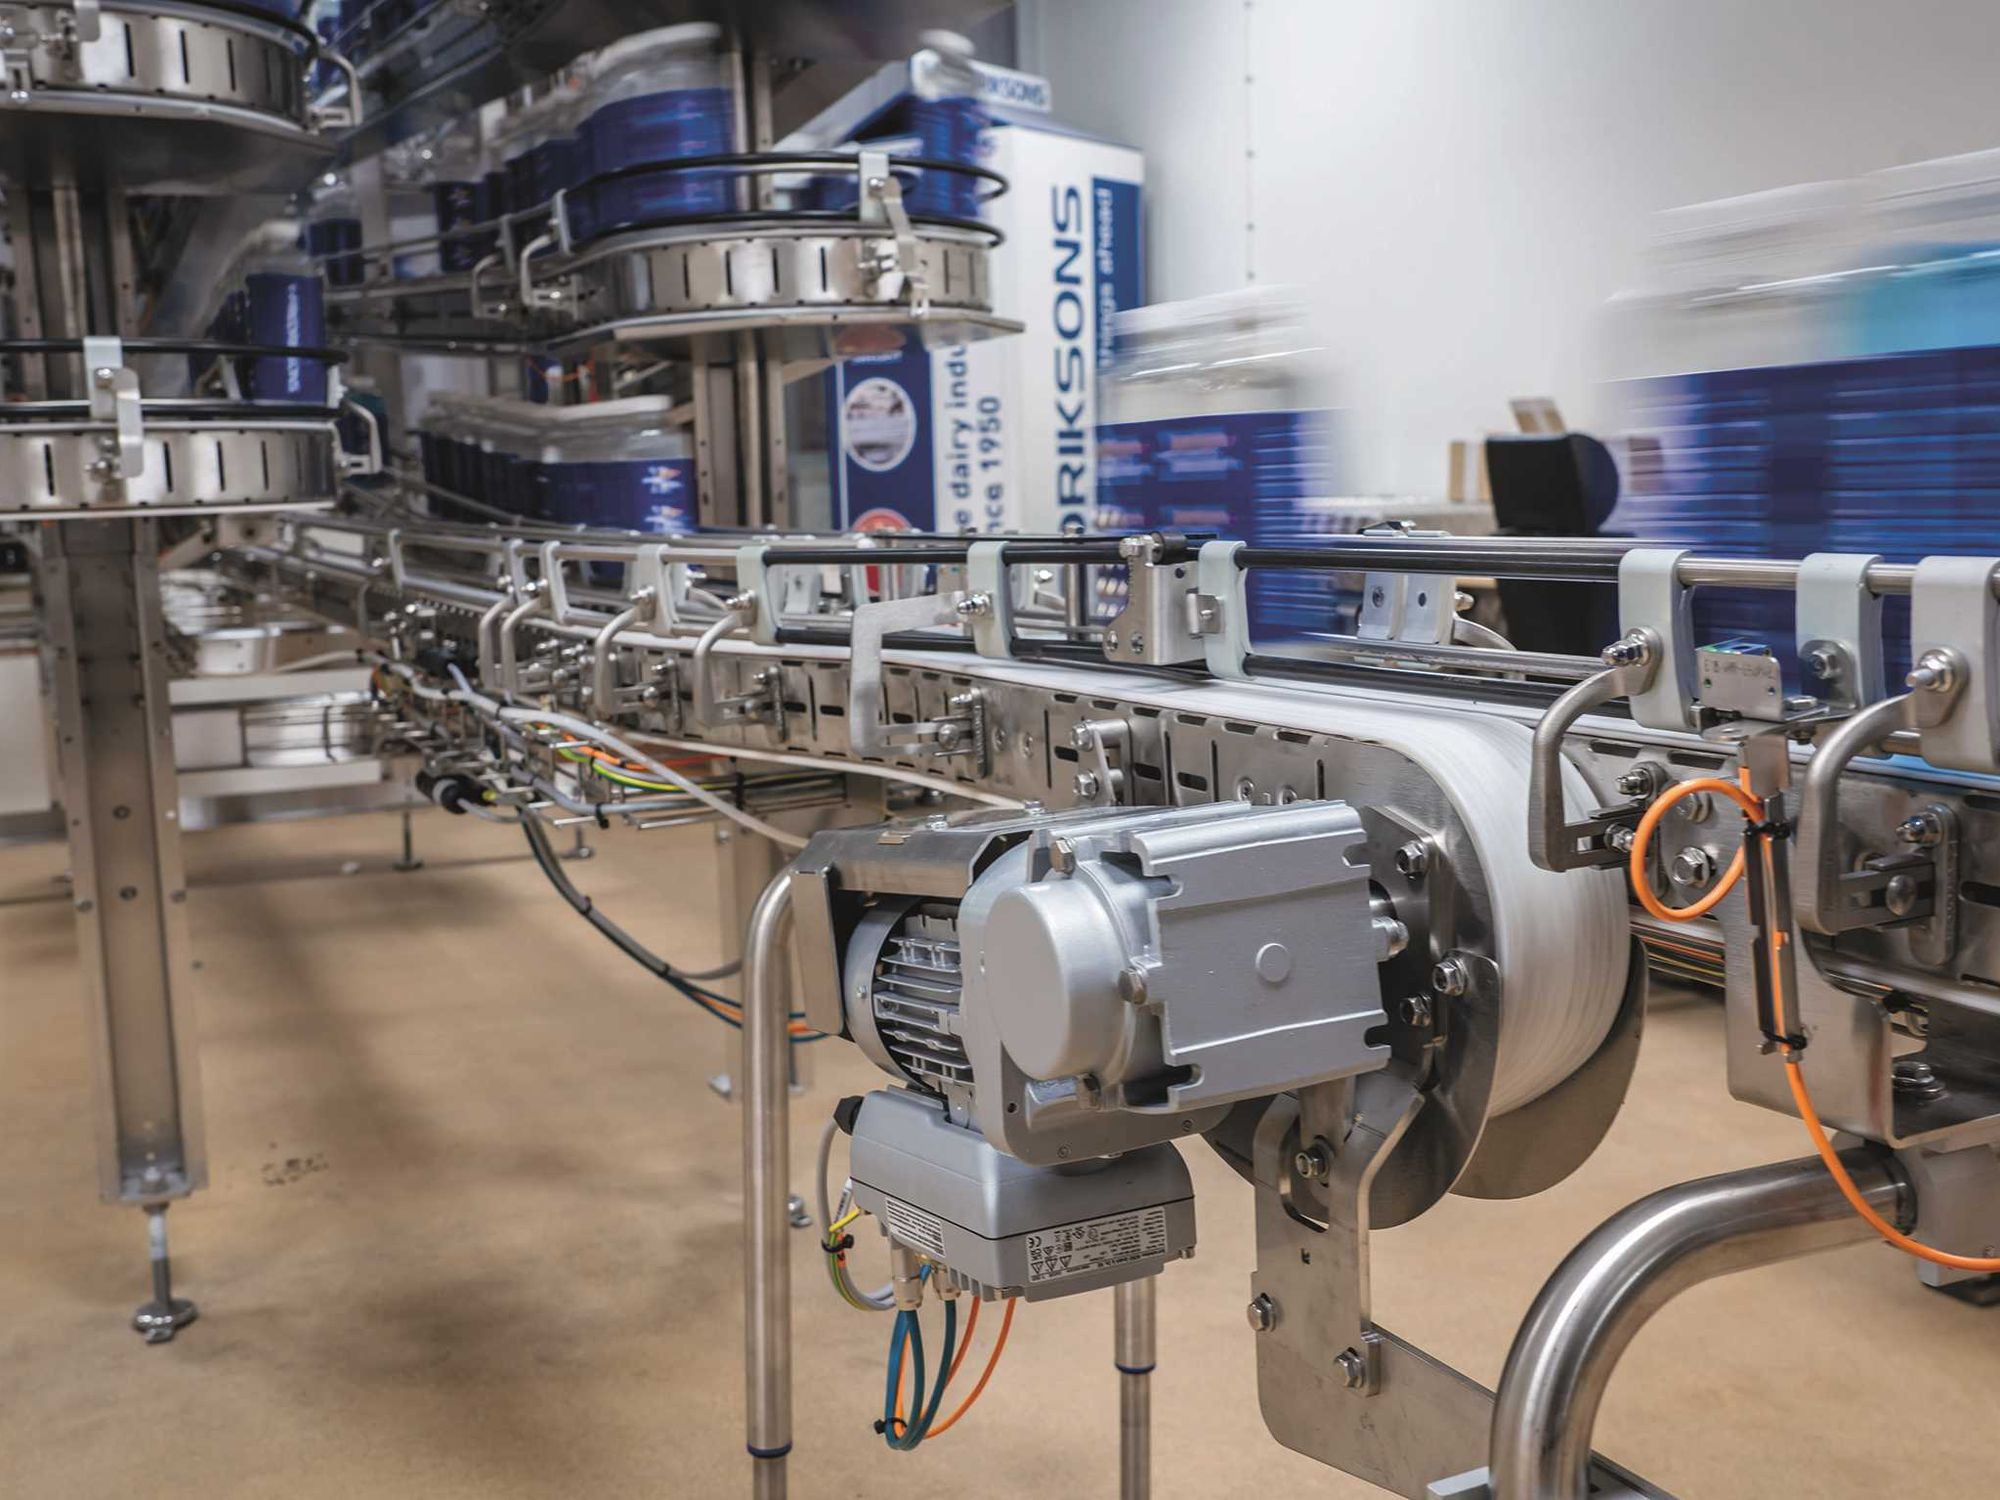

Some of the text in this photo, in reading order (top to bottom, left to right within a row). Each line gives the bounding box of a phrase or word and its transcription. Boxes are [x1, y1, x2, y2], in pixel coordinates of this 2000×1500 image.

[1097, 188, 1114, 275] ahead
[947, 418, 974, 498] dairy
[977, 397, 1001, 471] 1950
